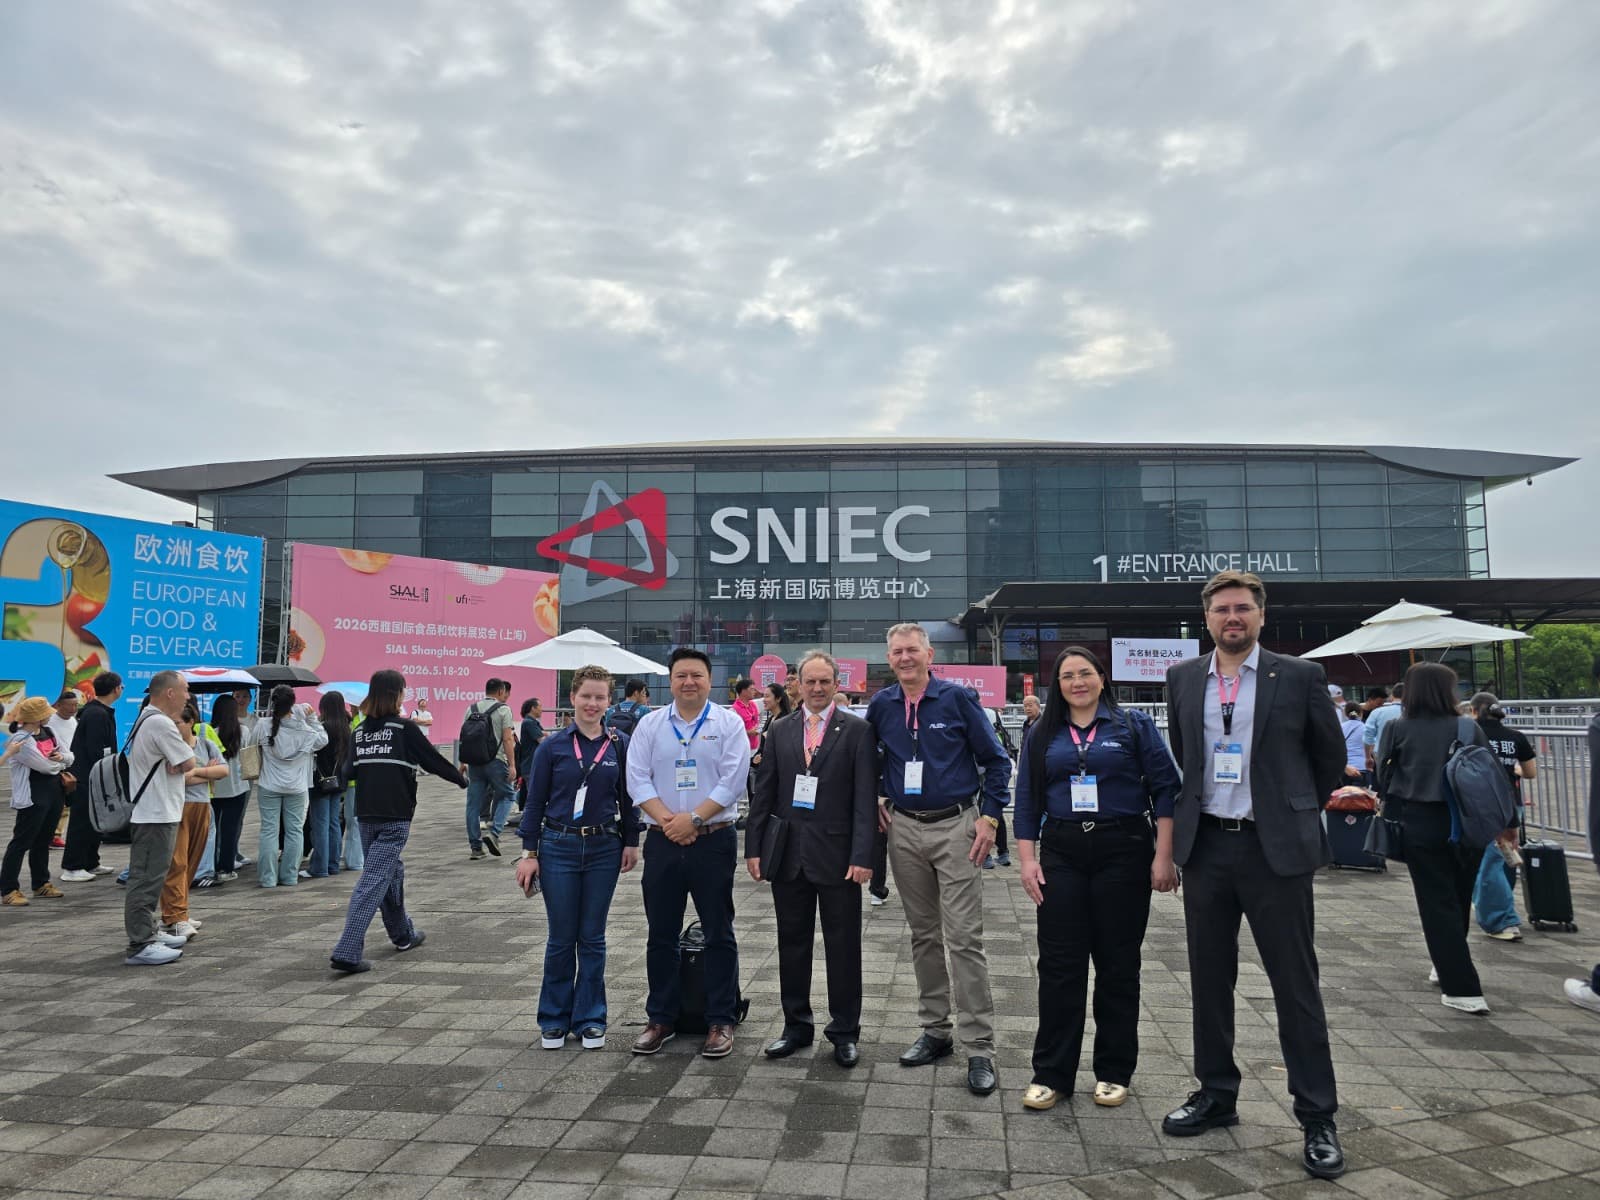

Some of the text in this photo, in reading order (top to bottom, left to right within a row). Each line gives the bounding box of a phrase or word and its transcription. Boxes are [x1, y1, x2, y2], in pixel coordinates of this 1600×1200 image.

[710, 505, 931, 564] SNIEC
[134, 534, 249, 574] 欧洲食饮
[1117, 553, 1242, 573] #ENTRANCE
[1247, 553, 1299, 572] HALL
[132, 581, 246, 608] EUROPEAN
[389, 585, 420, 598] SIAL
[709, 577, 931, 600] 上海新国际博览中心
[131, 608, 217, 631] FOOD &
[129, 635, 243, 659] BEVERAGE
[385, 644, 485, 658] SIAL Shanghai 2026
[1128, 649, 1183, 658] 实名制登记入场
[402, 665, 470, 677] 2026.5.18-20
[433, 687, 487, 701] Welcom
